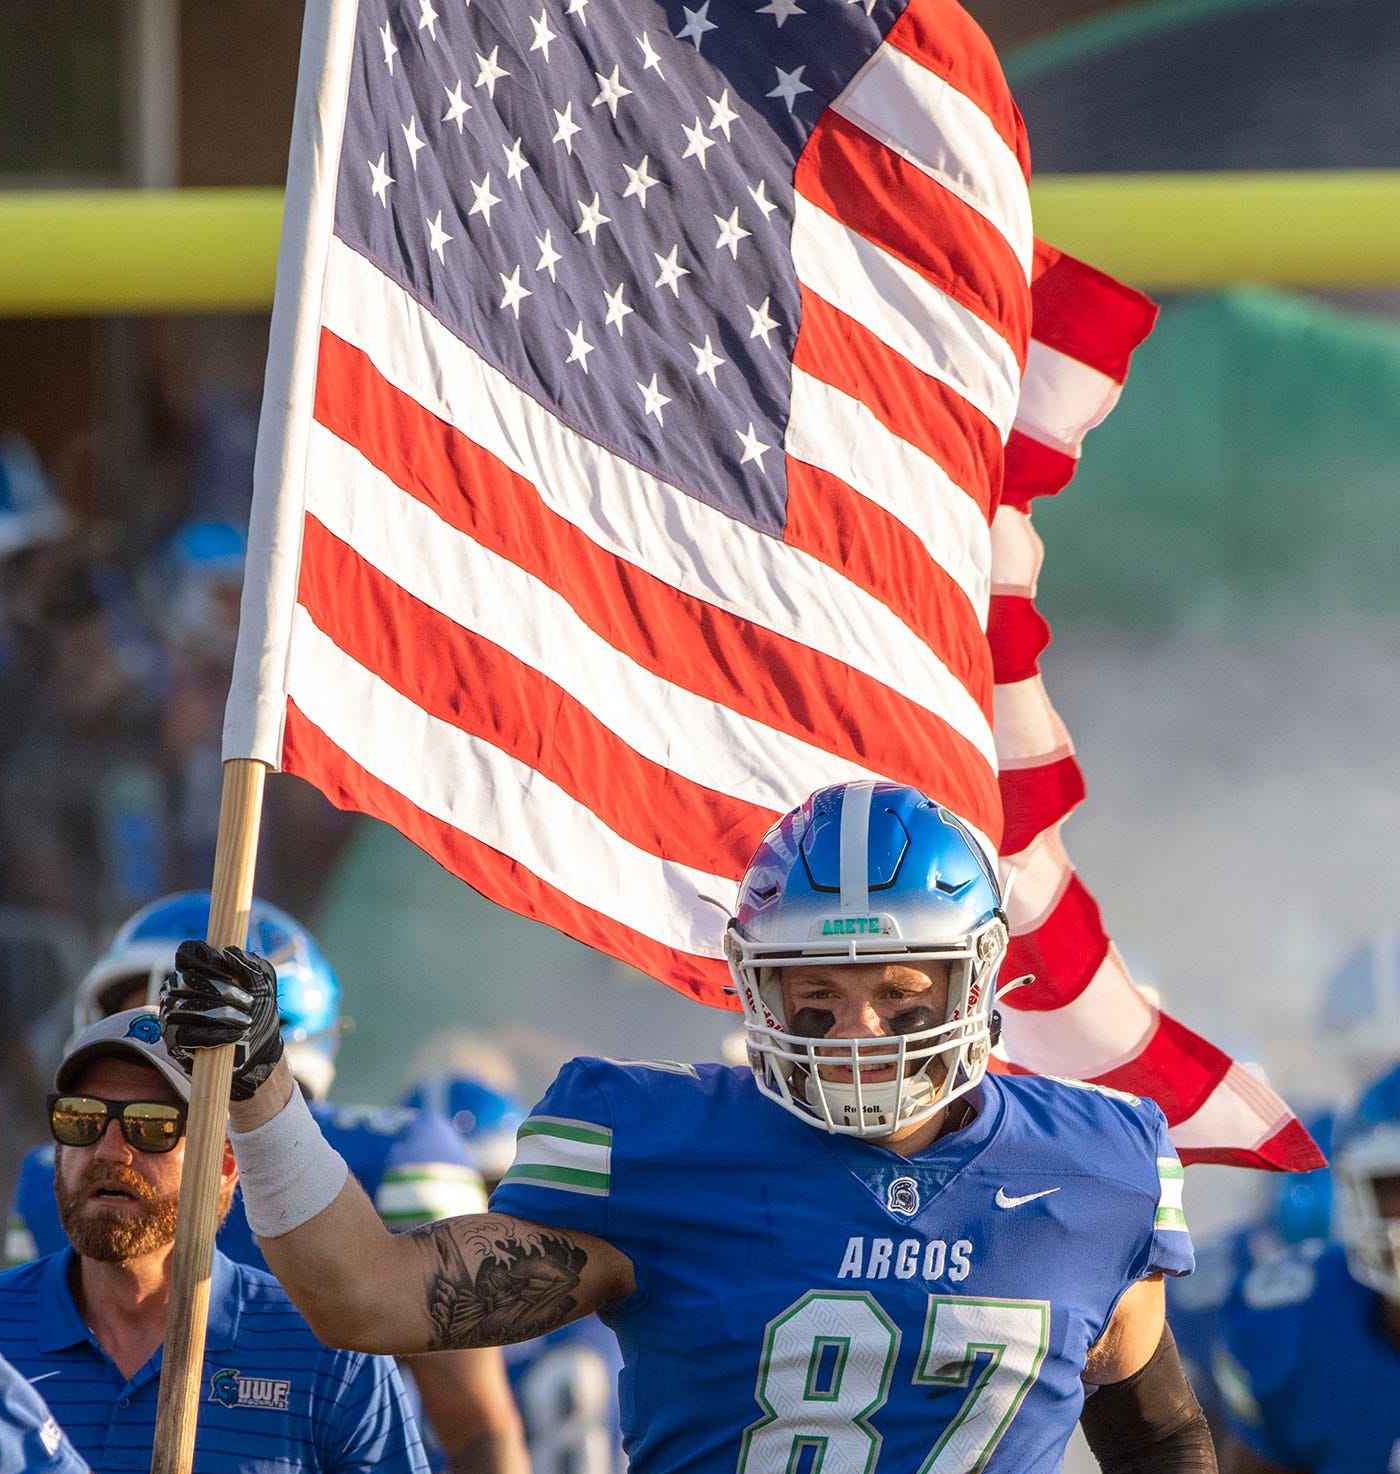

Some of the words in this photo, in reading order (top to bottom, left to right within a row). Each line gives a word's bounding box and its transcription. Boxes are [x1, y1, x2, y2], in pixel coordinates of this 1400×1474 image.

[822, 918, 879, 935] ARETE
[837, 1236, 973, 1282] ARGOS
[238, 1380, 288, 1402] UWF
